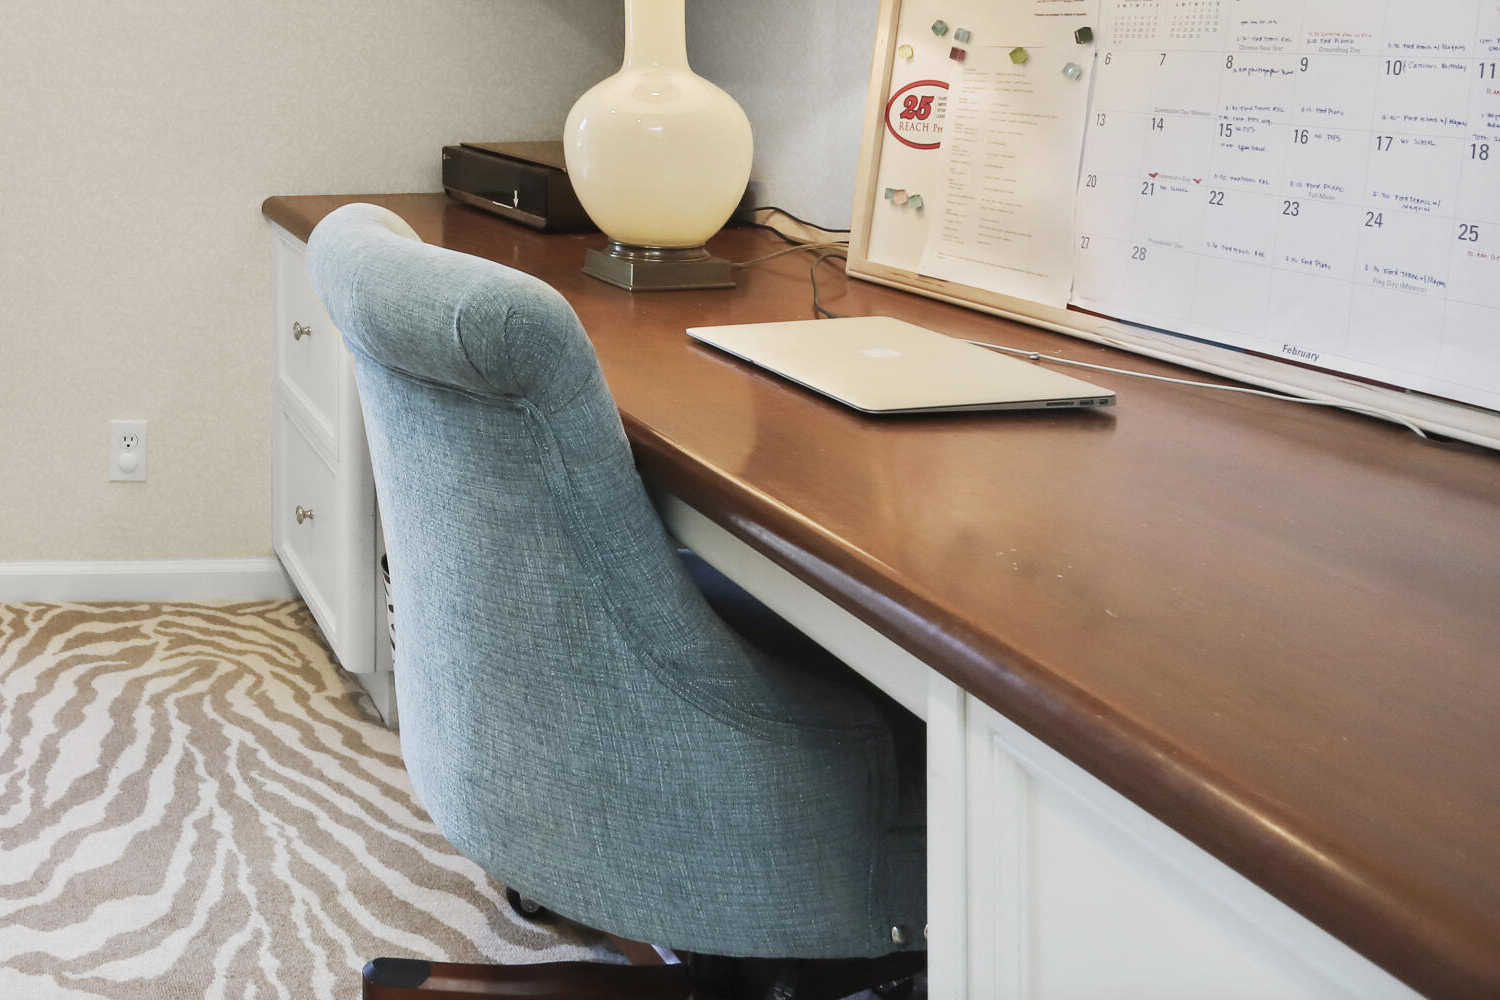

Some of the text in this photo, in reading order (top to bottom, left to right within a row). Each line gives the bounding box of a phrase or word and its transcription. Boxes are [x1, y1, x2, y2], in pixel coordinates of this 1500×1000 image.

[1104, 53, 1112, 65] 6
[1160, 53, 1167, 67] 7
[1226, 55, 1234, 69] 8
[1300, 57, 1309, 72] 9
[1385, 60, 1403, 76] 10
[1479, 62, 1496, 79] 11
[900, 95, 934, 120] 25
[899, 122, 929, 133] REACH
[1096, 113, 1106, 127] 13
[1152, 117, 1164, 132] 14
[1219, 123, 1233, 138] 15
[1294, 129, 1309, 145] 16
[1377, 135, 1393, 152] 17
[1470, 143, 1490, 161] 18
[1086, 174, 1097, 188] 20
[1141, 181, 1155, 197] 21
[1208, 190, 1225, 206] 22
[1282, 200, 1300, 217] 23
[1365, 211, 1383, 229] 24
[1457, 223, 1479, 242] 25
[1081, 235, 1091, 249] 27
[1131, 245, 1147, 261] 28
[1282, 344, 1320, 362] February
